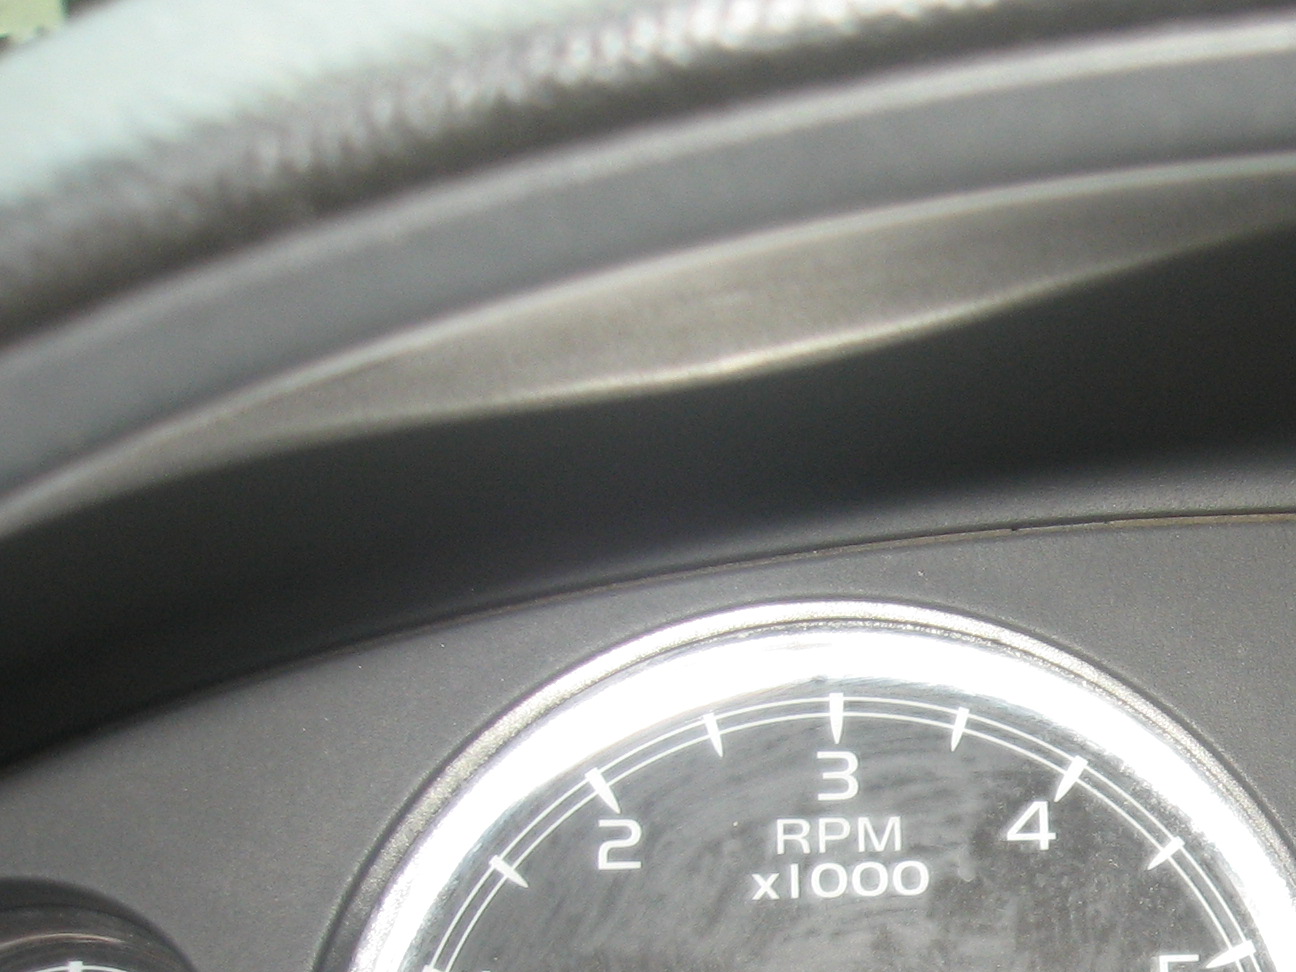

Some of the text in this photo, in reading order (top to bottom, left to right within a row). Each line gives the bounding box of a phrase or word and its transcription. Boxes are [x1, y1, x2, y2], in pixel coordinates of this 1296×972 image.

[816, 751, 858, 801] 3
[598, 819, 642, 870] 2
[776, 816, 902, 855] RPM
[1006, 801, 1057, 851] 4
[751, 860, 930, 901] x1000
